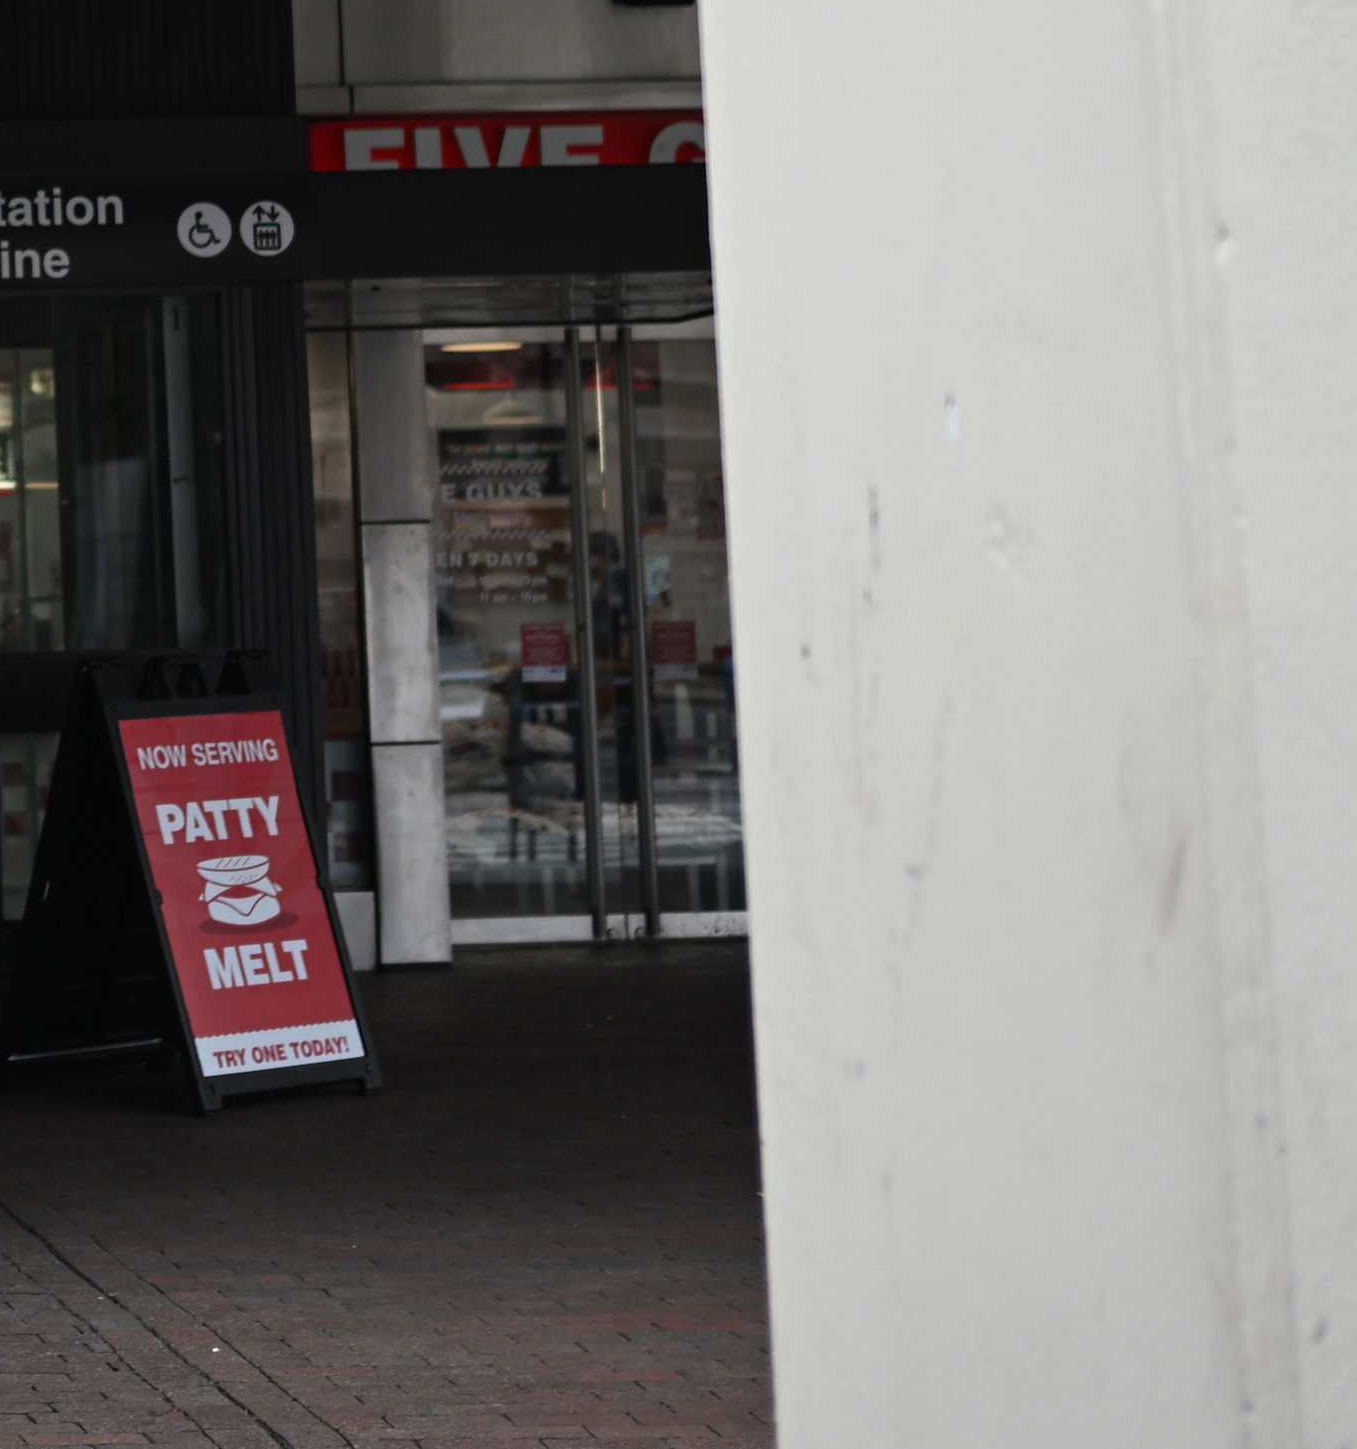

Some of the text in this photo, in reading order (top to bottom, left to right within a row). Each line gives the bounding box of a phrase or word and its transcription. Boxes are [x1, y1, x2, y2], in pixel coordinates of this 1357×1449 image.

[465, 481, 543, 503] GUYS
[486, 552, 539, 568] DAYS
[137, 738, 279, 770] NOW SERVING
[154, 795, 280, 846] PATTY
[203, 939, 308, 990] MELT
[213, 1036, 349, 1069] TRY ONE TODAY!
